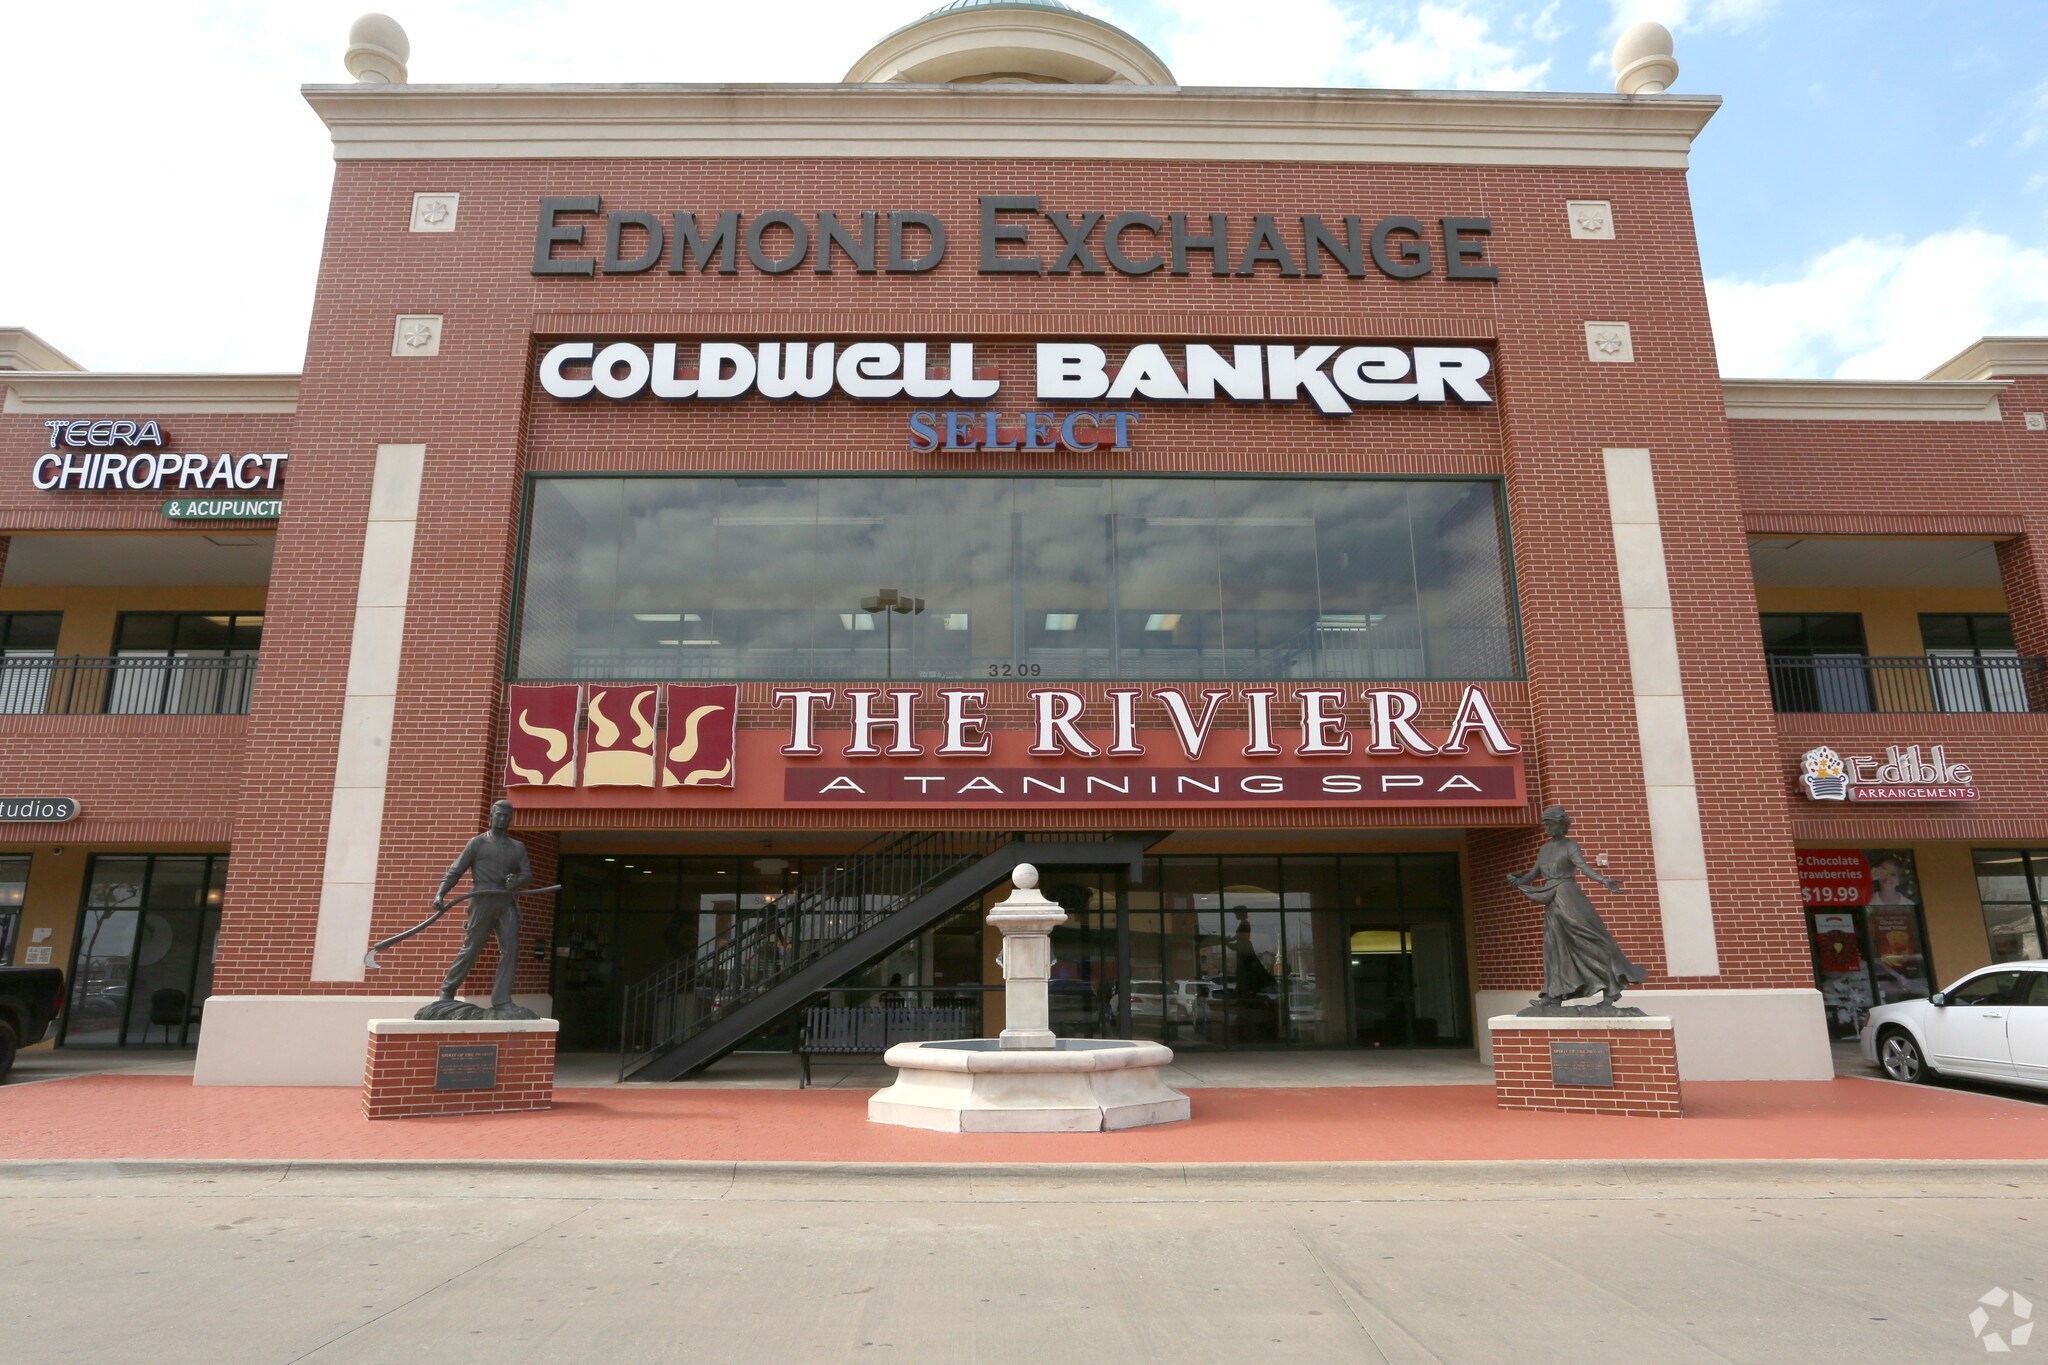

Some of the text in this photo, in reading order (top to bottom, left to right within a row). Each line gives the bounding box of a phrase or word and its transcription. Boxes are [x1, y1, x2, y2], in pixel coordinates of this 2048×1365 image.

[531, 195, 1498, 284] EDMOND EXCHANGE
[540, 342, 1493, 417] COLDWELL BANKER
[44, 420, 162, 448] TEERA
[909, 411, 1140, 453] SELECT
[32, 453, 288, 489] CHIROPRACT
[168, 501, 181, 516] &
[988, 663, 1041, 677] 3209
[772, 684, 1522, 759] THE RIVIERA
[1847, 745, 1973, 784] Edible
[818, 775, 1482, 794] A TANNING SPA
[1858, 788, 1975, 798] ARRANGEMENTS
[1806, 855, 1860, 866] Chocolate
[1802, 886, 1859, 903] $19.99
